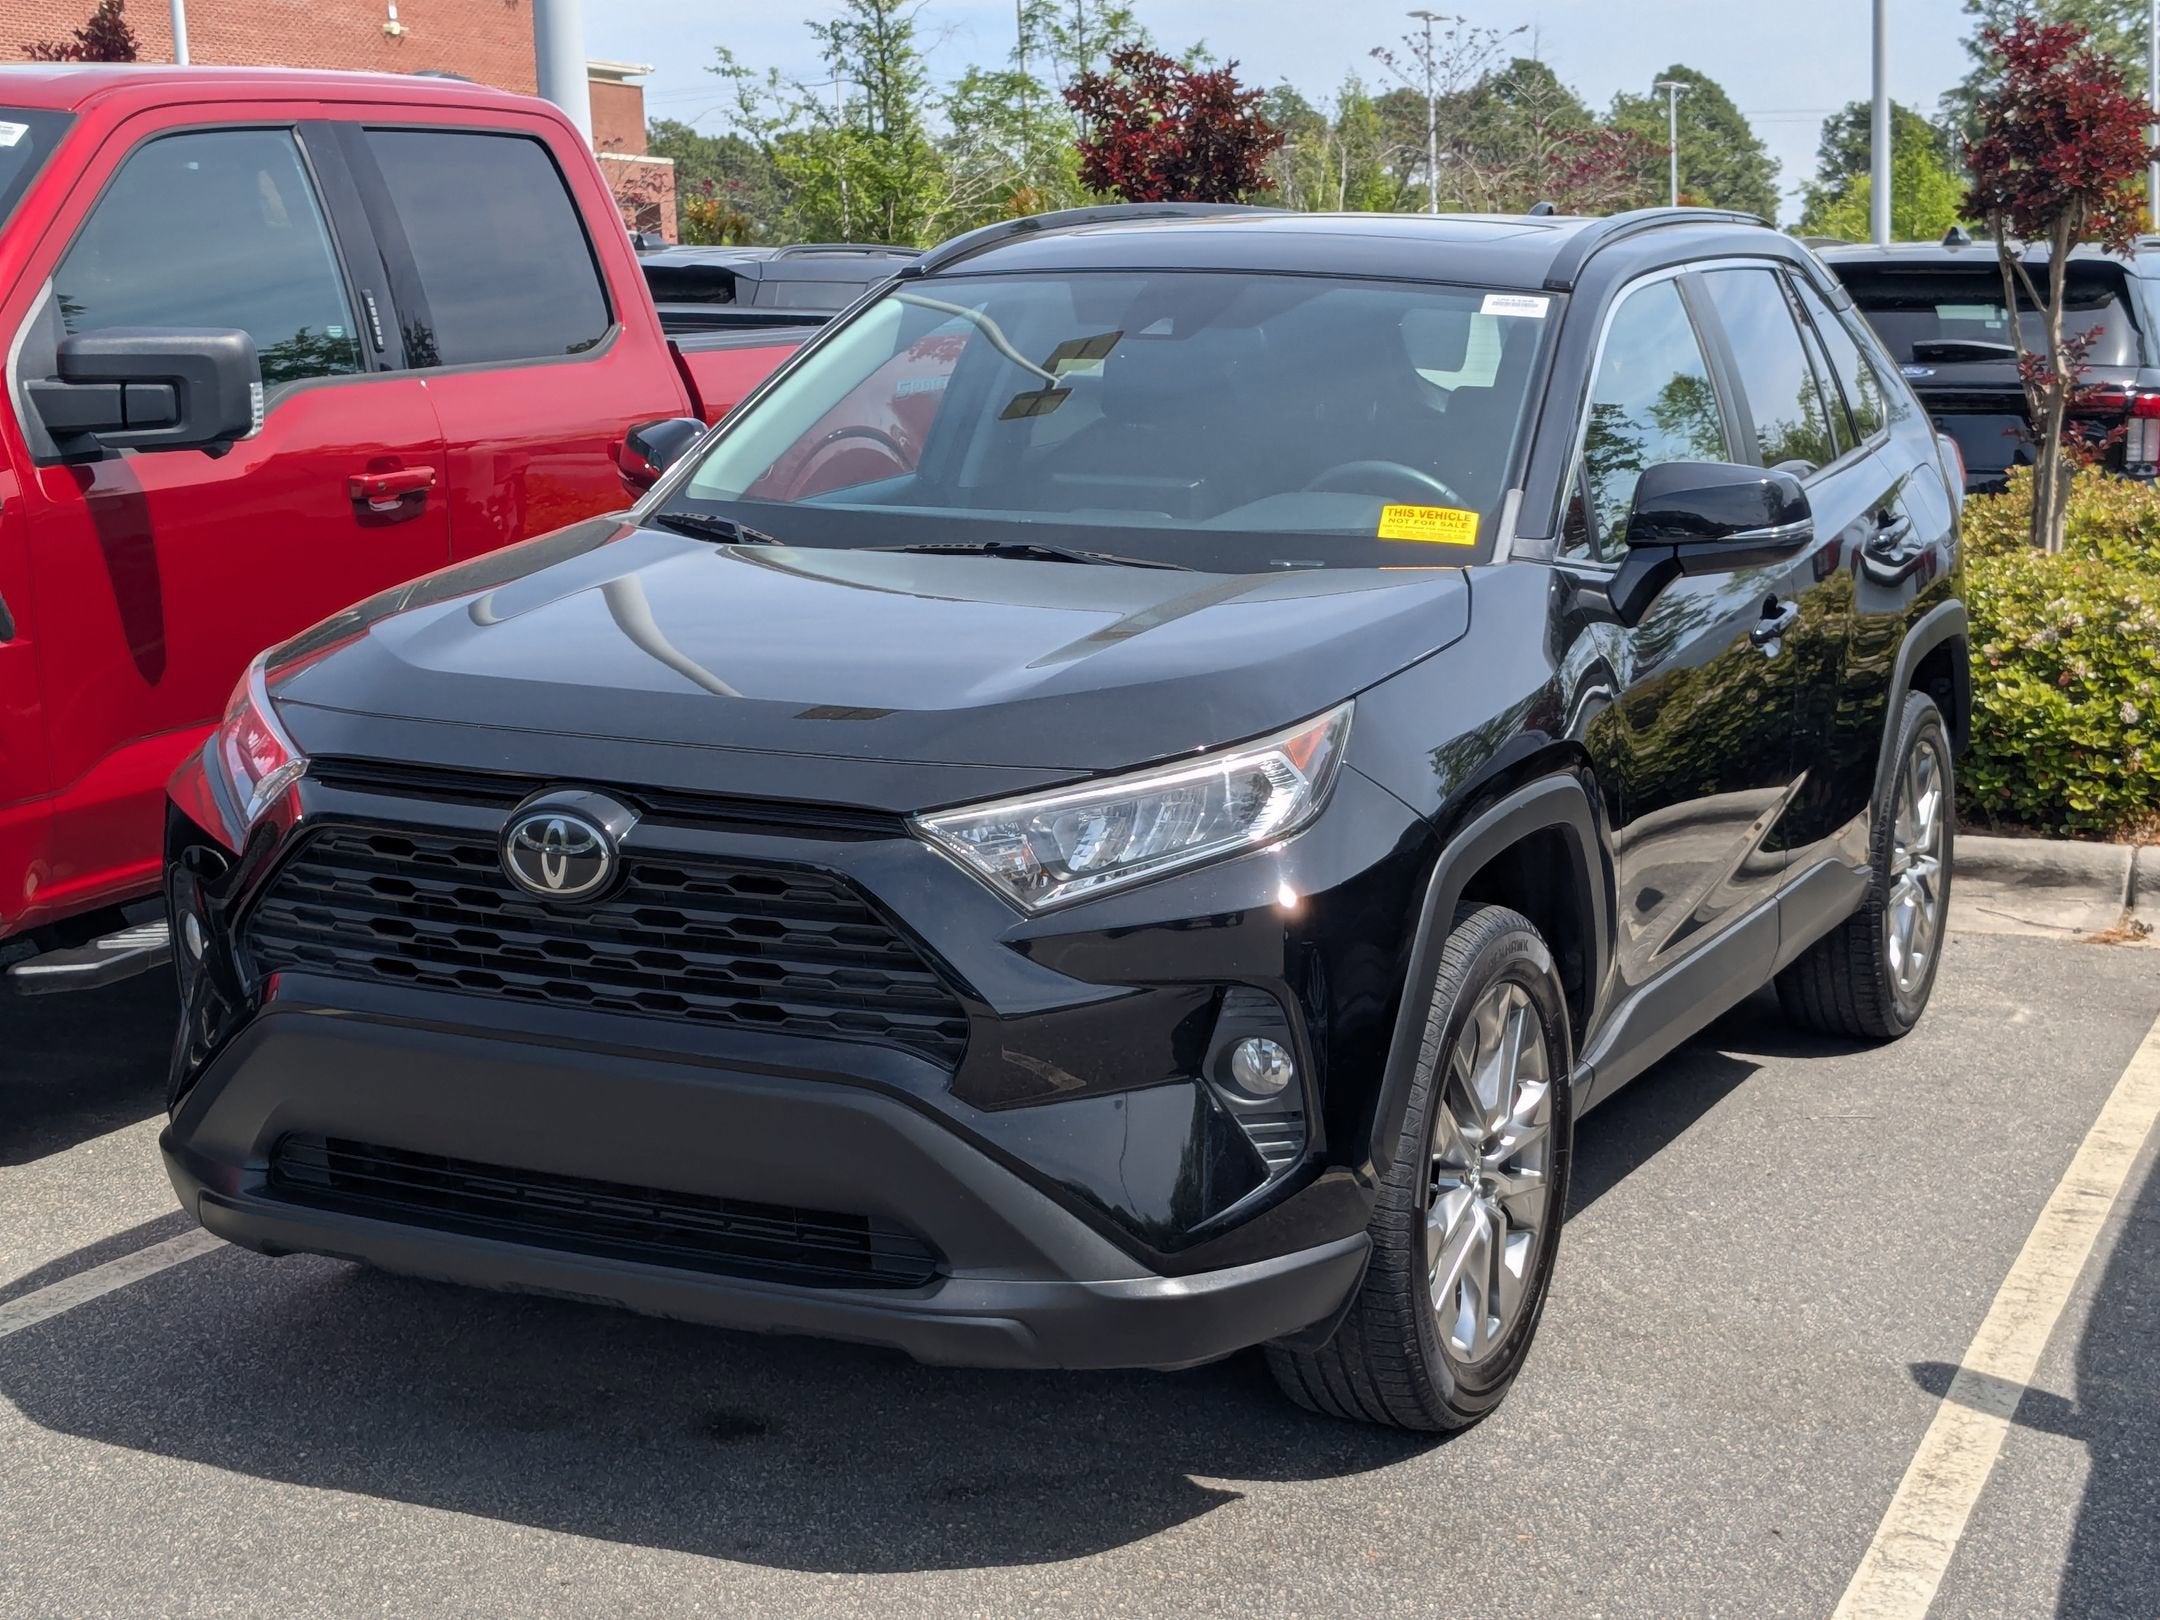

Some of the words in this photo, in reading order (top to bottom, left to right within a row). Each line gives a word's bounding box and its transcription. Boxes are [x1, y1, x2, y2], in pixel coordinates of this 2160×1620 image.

[1388, 508, 1415, 518] THIS
[1419, 509, 1471, 521] VEHICLE
[1440, 521, 1469, 529] SALE
